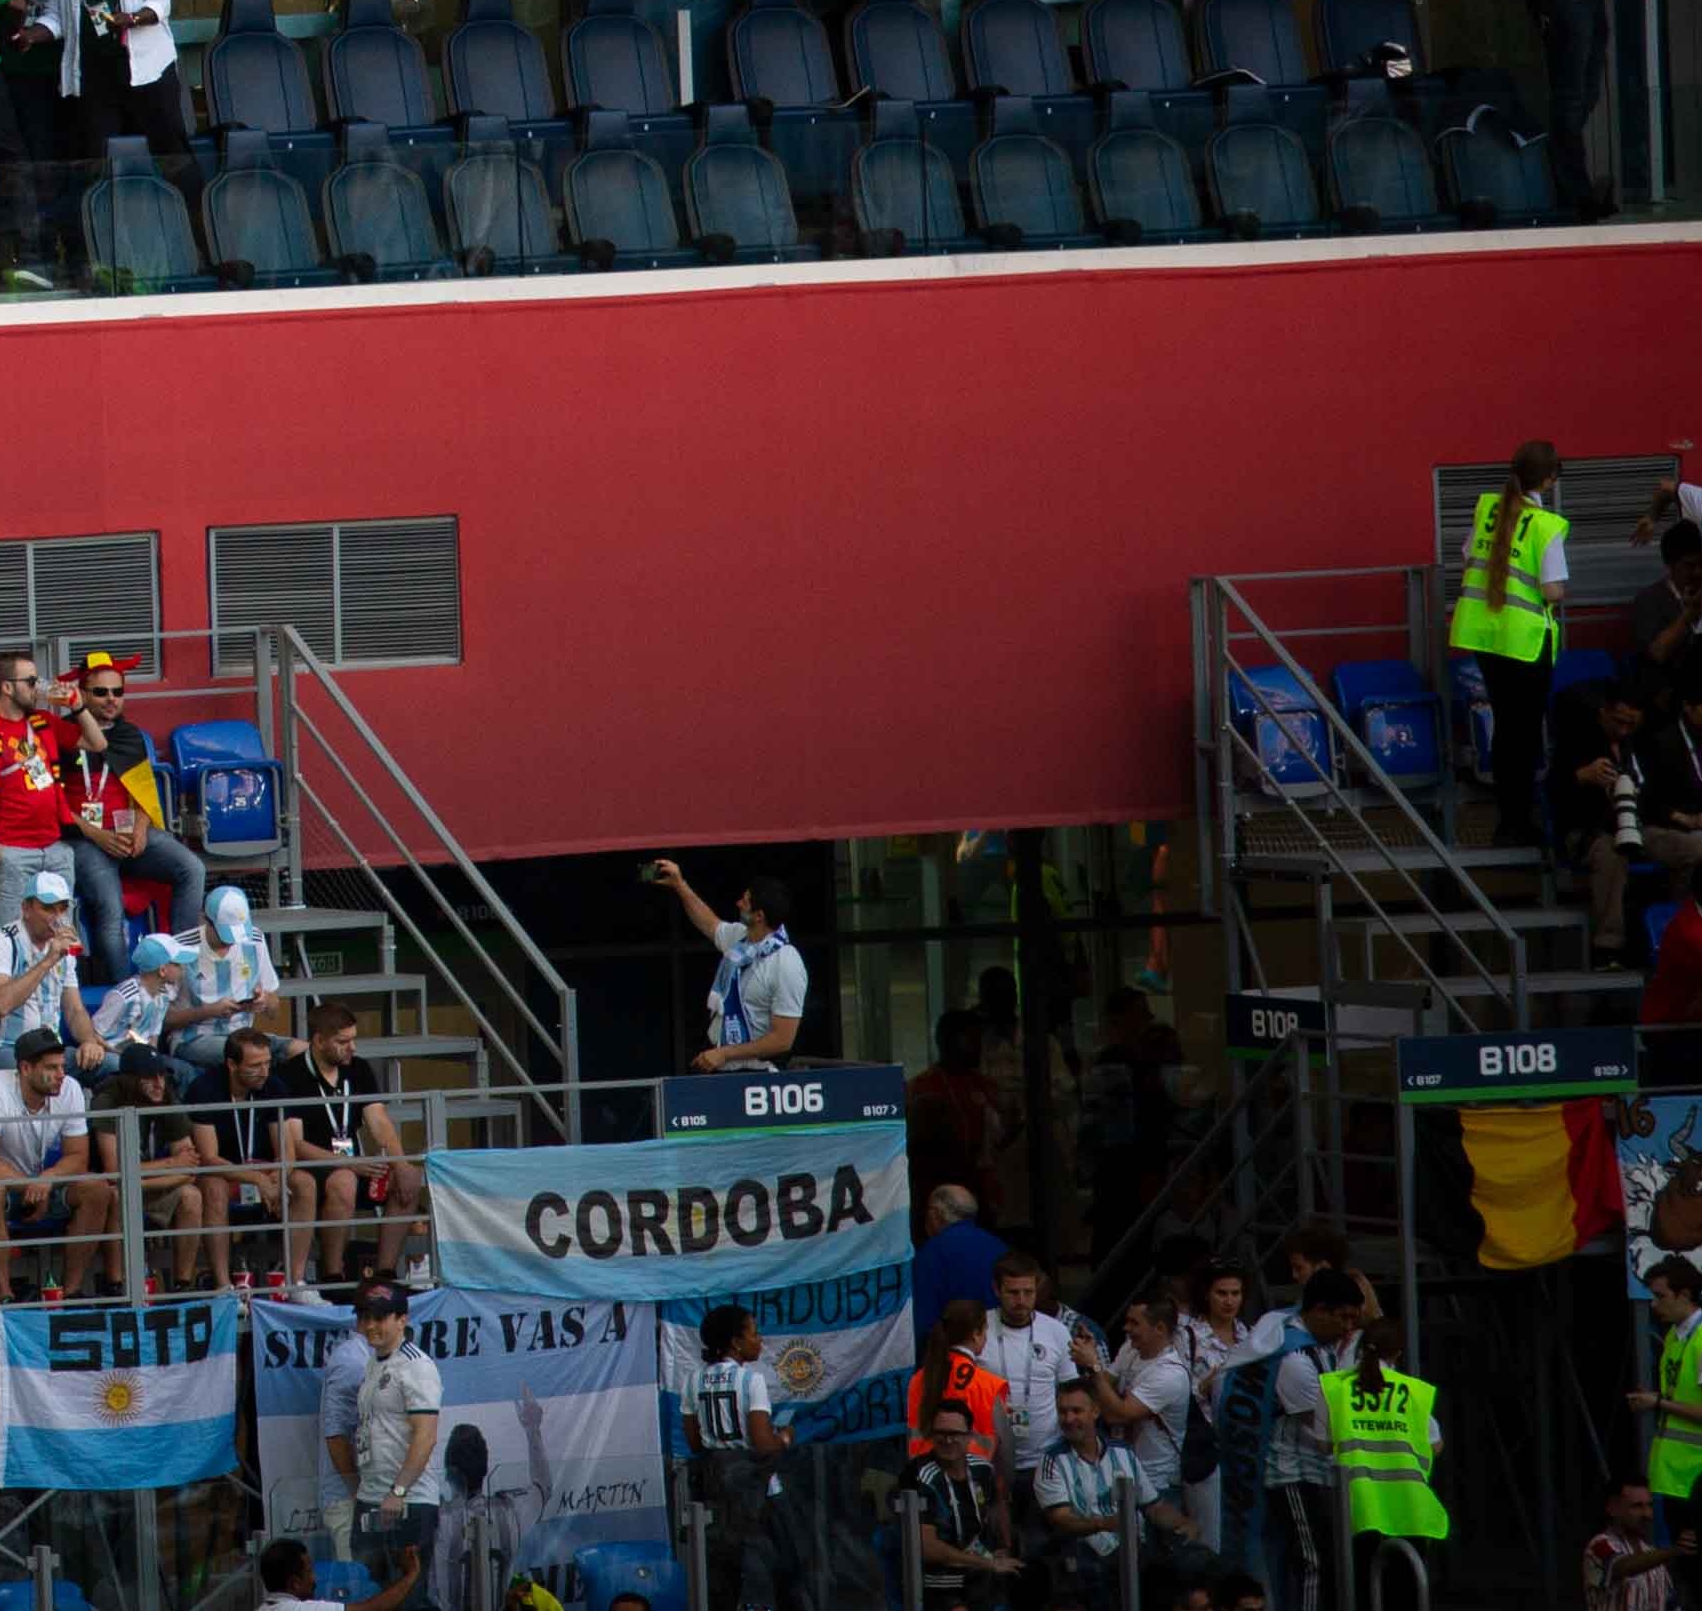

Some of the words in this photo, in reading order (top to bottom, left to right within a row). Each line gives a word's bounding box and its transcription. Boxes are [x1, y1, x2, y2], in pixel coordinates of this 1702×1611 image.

[1479, 1044, 1557, 1075] B108
[681, 1115, 706, 1127] B105
[744, 1083, 824, 1117] B106
[863, 1105, 888, 1117] B107
[525, 1165, 874, 1260] CORDOBA
[48, 1302, 213, 1373] SOTO
[500, 1305, 587, 1354] VAS
[597, 1300, 630, 1345] A
[696, 1391, 741, 1443] 10
